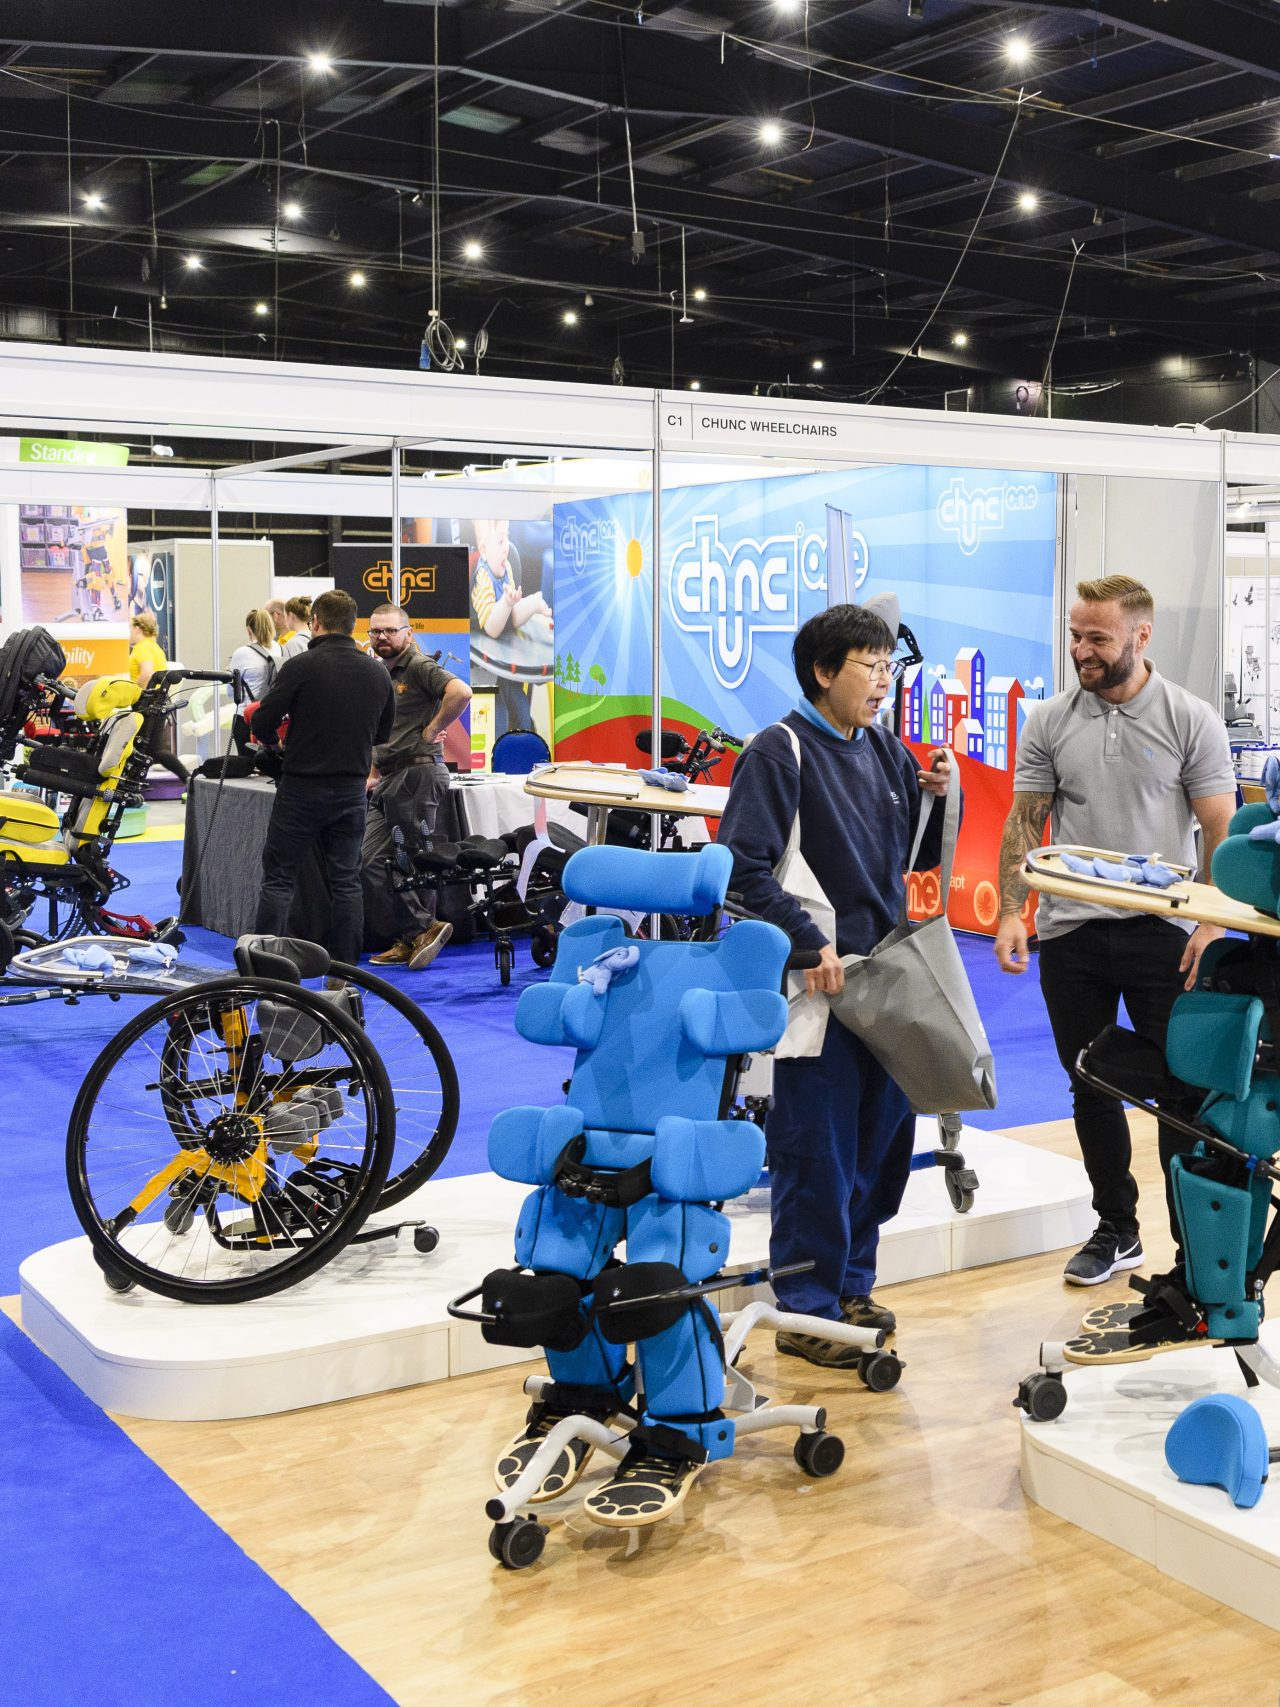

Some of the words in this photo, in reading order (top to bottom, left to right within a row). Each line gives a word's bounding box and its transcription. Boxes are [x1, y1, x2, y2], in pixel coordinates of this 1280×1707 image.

[667, 415, 683, 427] C1
[701, 417, 747, 431] CHUNC
[750, 420, 838, 437] WHEELCHAIRS
[672, 527, 792, 675] chunc
[63, 646, 95, 669] bility
